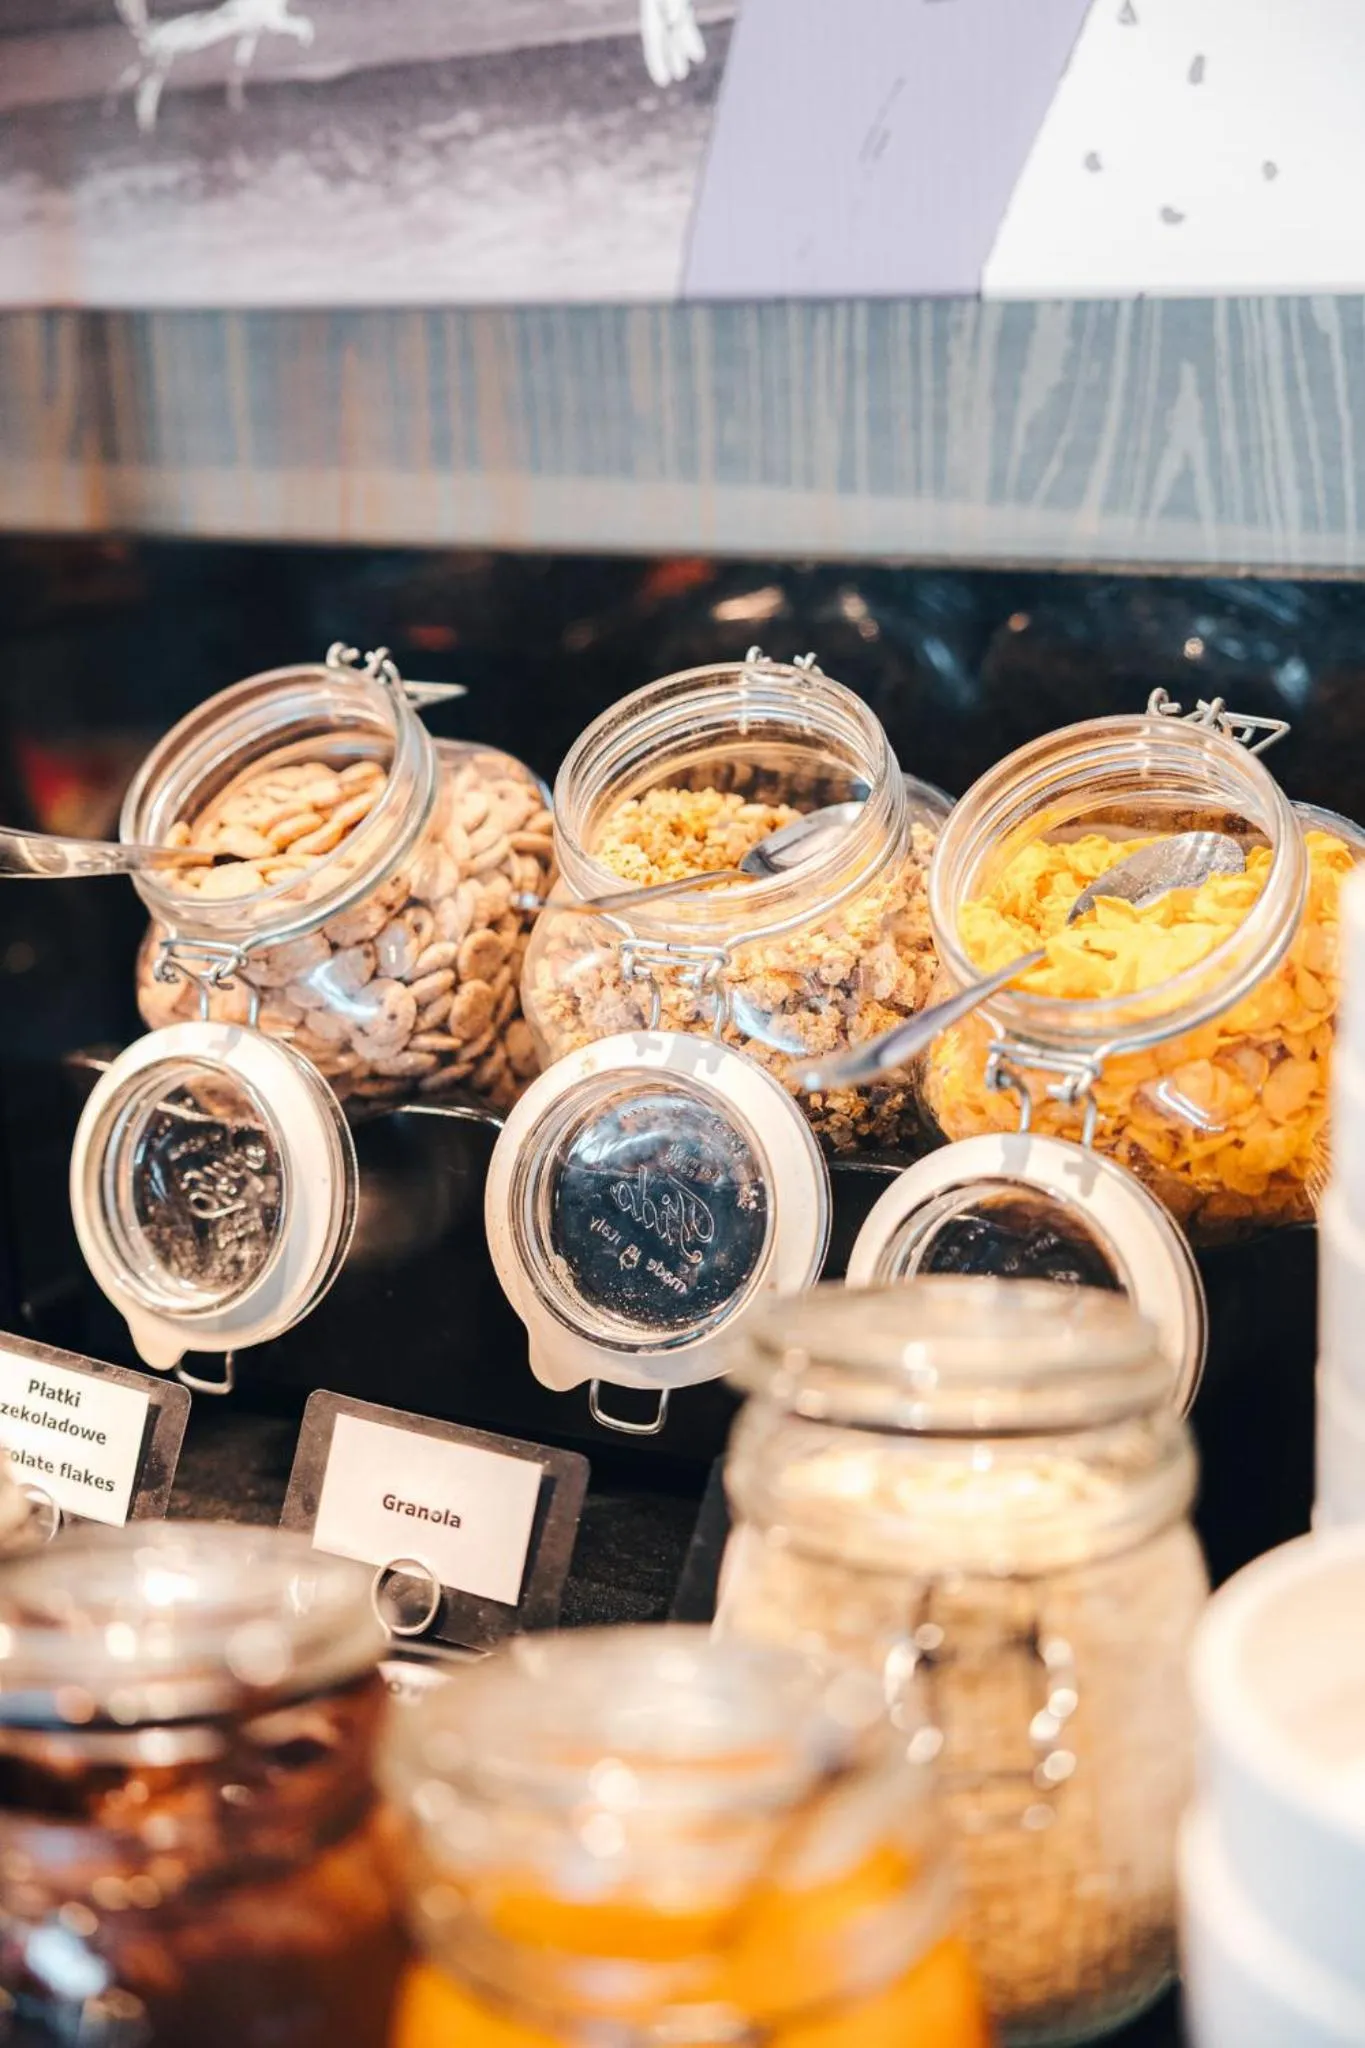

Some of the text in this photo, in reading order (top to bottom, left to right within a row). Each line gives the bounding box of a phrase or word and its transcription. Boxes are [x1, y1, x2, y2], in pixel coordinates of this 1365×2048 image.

[28, 1379, 81, 1408] Płatki
[0, 1403, 107, 1446] zekoladowe
[9, 1449, 116, 1492] olate flakes
[382, 1493, 462, 1529] Granola
